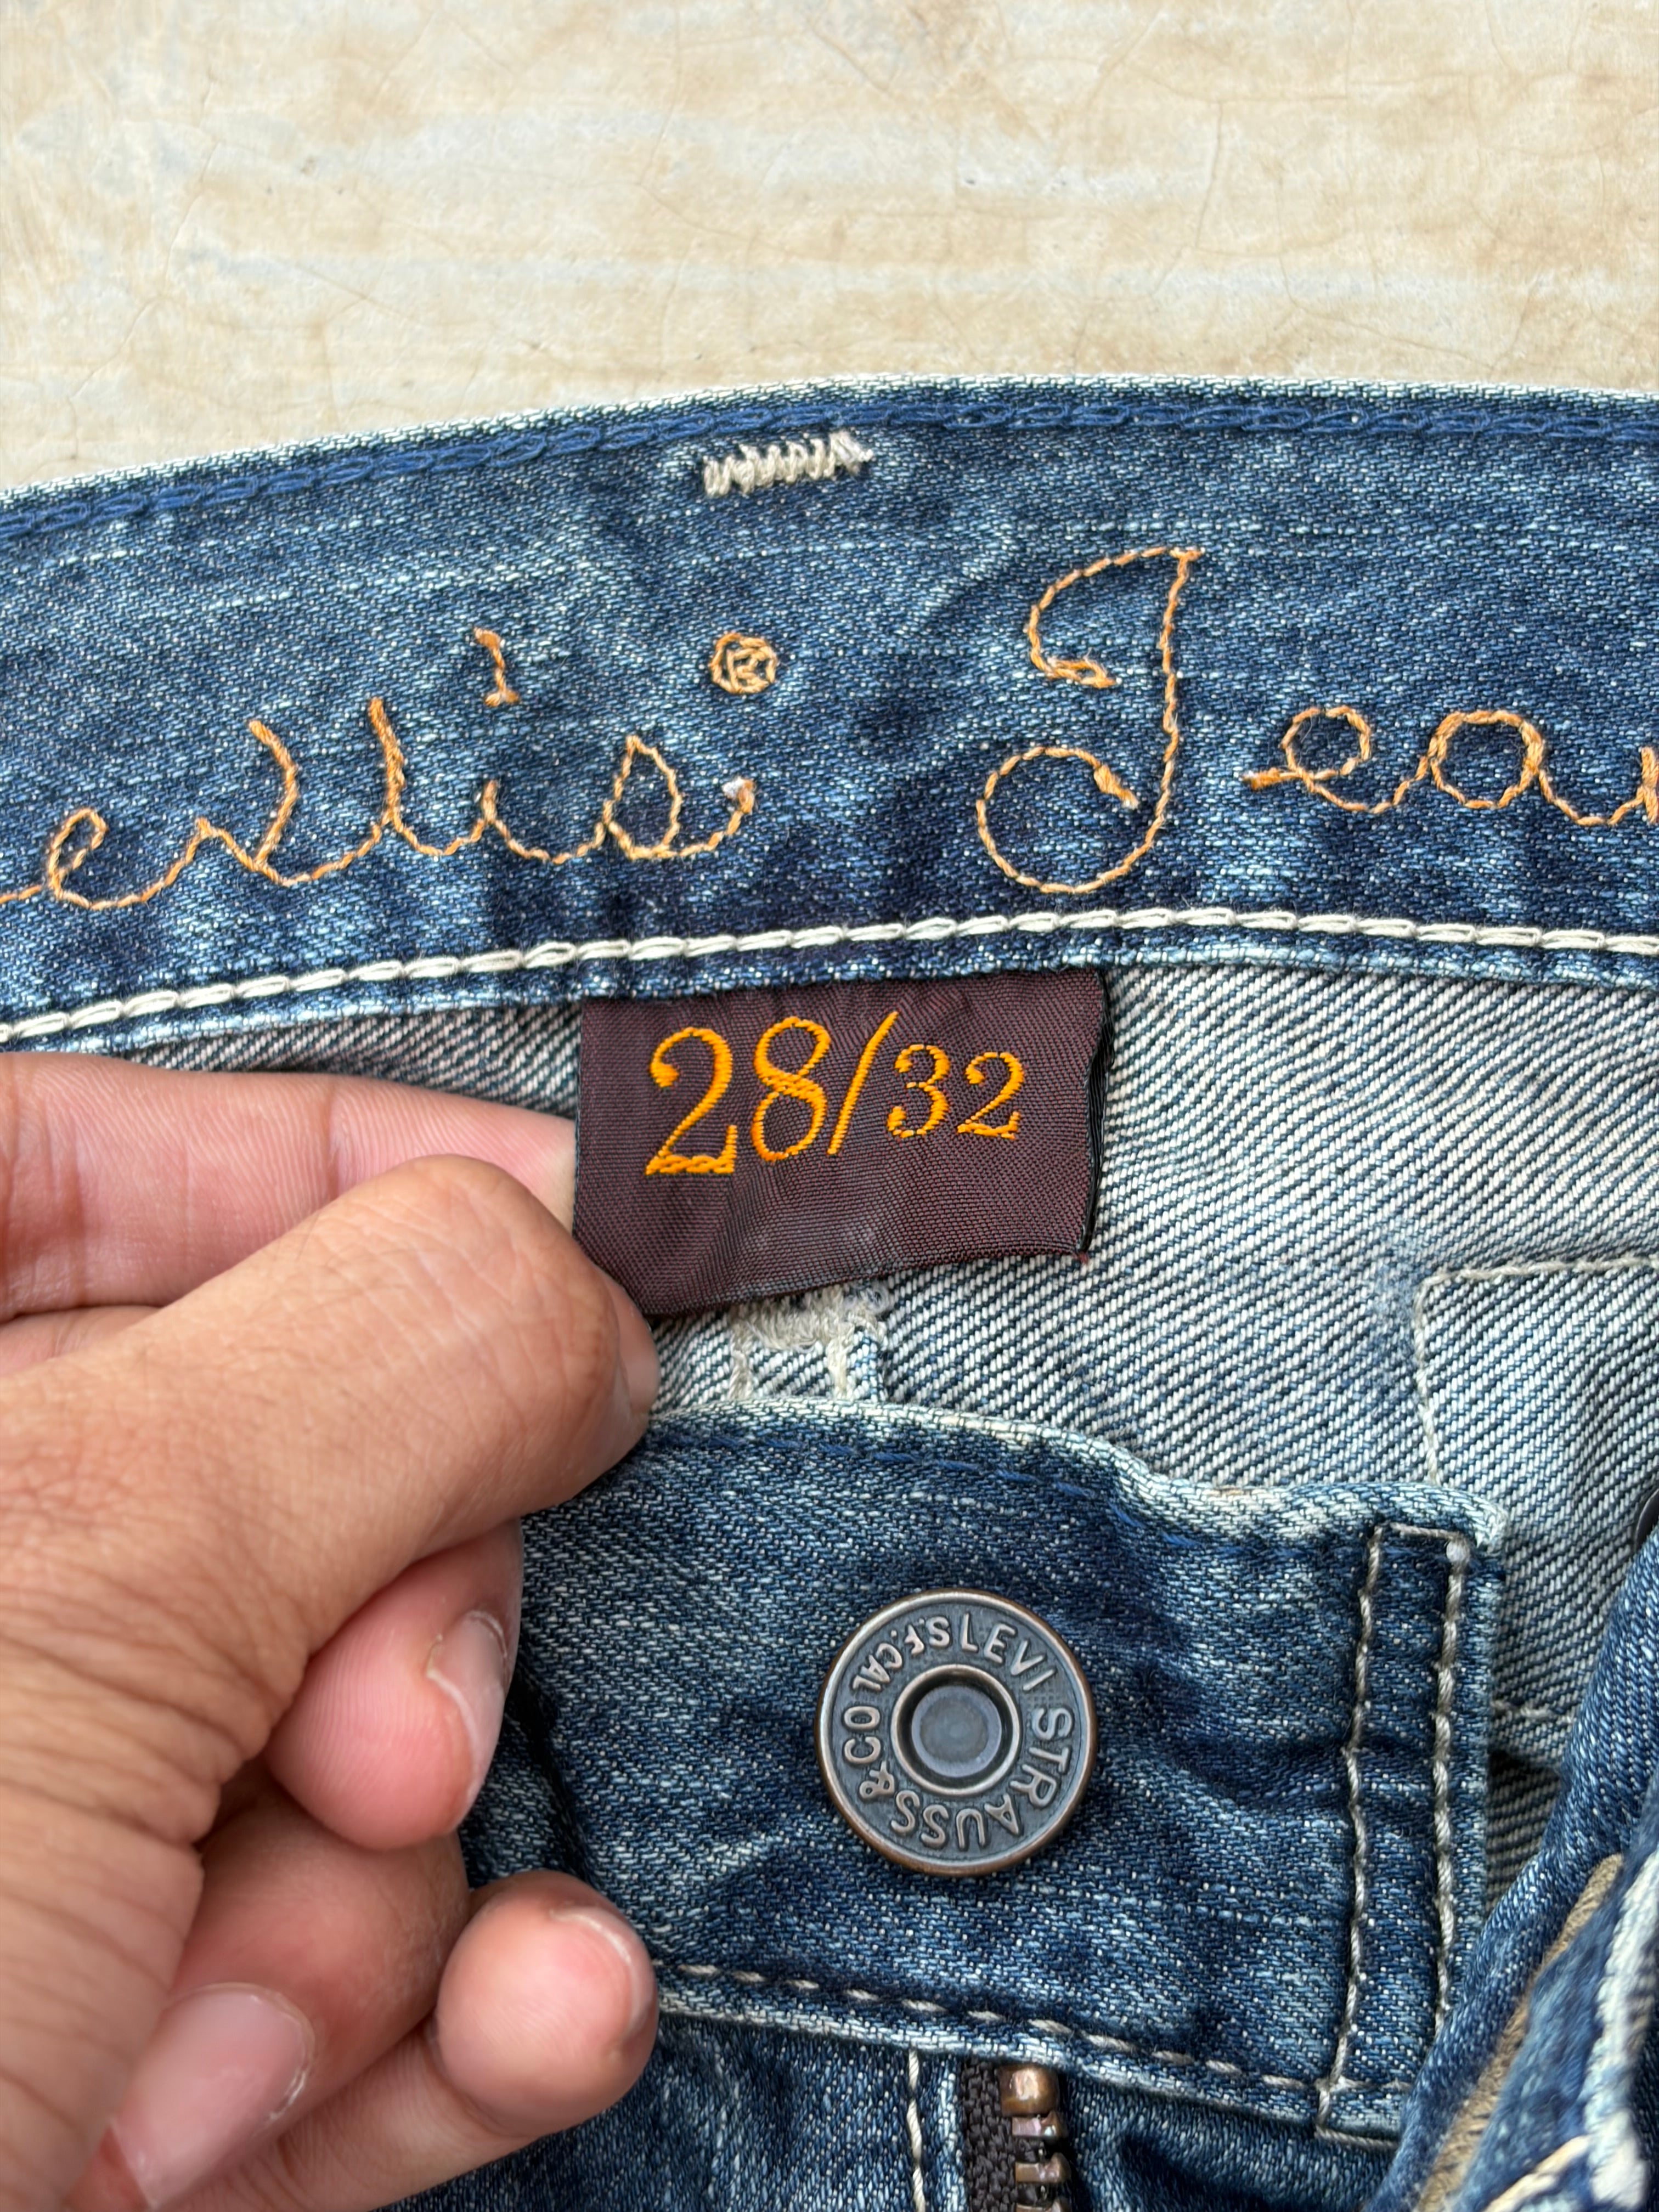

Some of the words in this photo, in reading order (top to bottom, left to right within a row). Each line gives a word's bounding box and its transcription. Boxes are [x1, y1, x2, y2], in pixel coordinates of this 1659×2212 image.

[0, 627, 755, 909] evi's
[645, 1010, 1026, 1175] 28/32
[960, 1612, 1057, 1692] LEVI
[844, 1706, 881, 1765] CO
[890, 1707, 1074, 1850] STRAUSS
